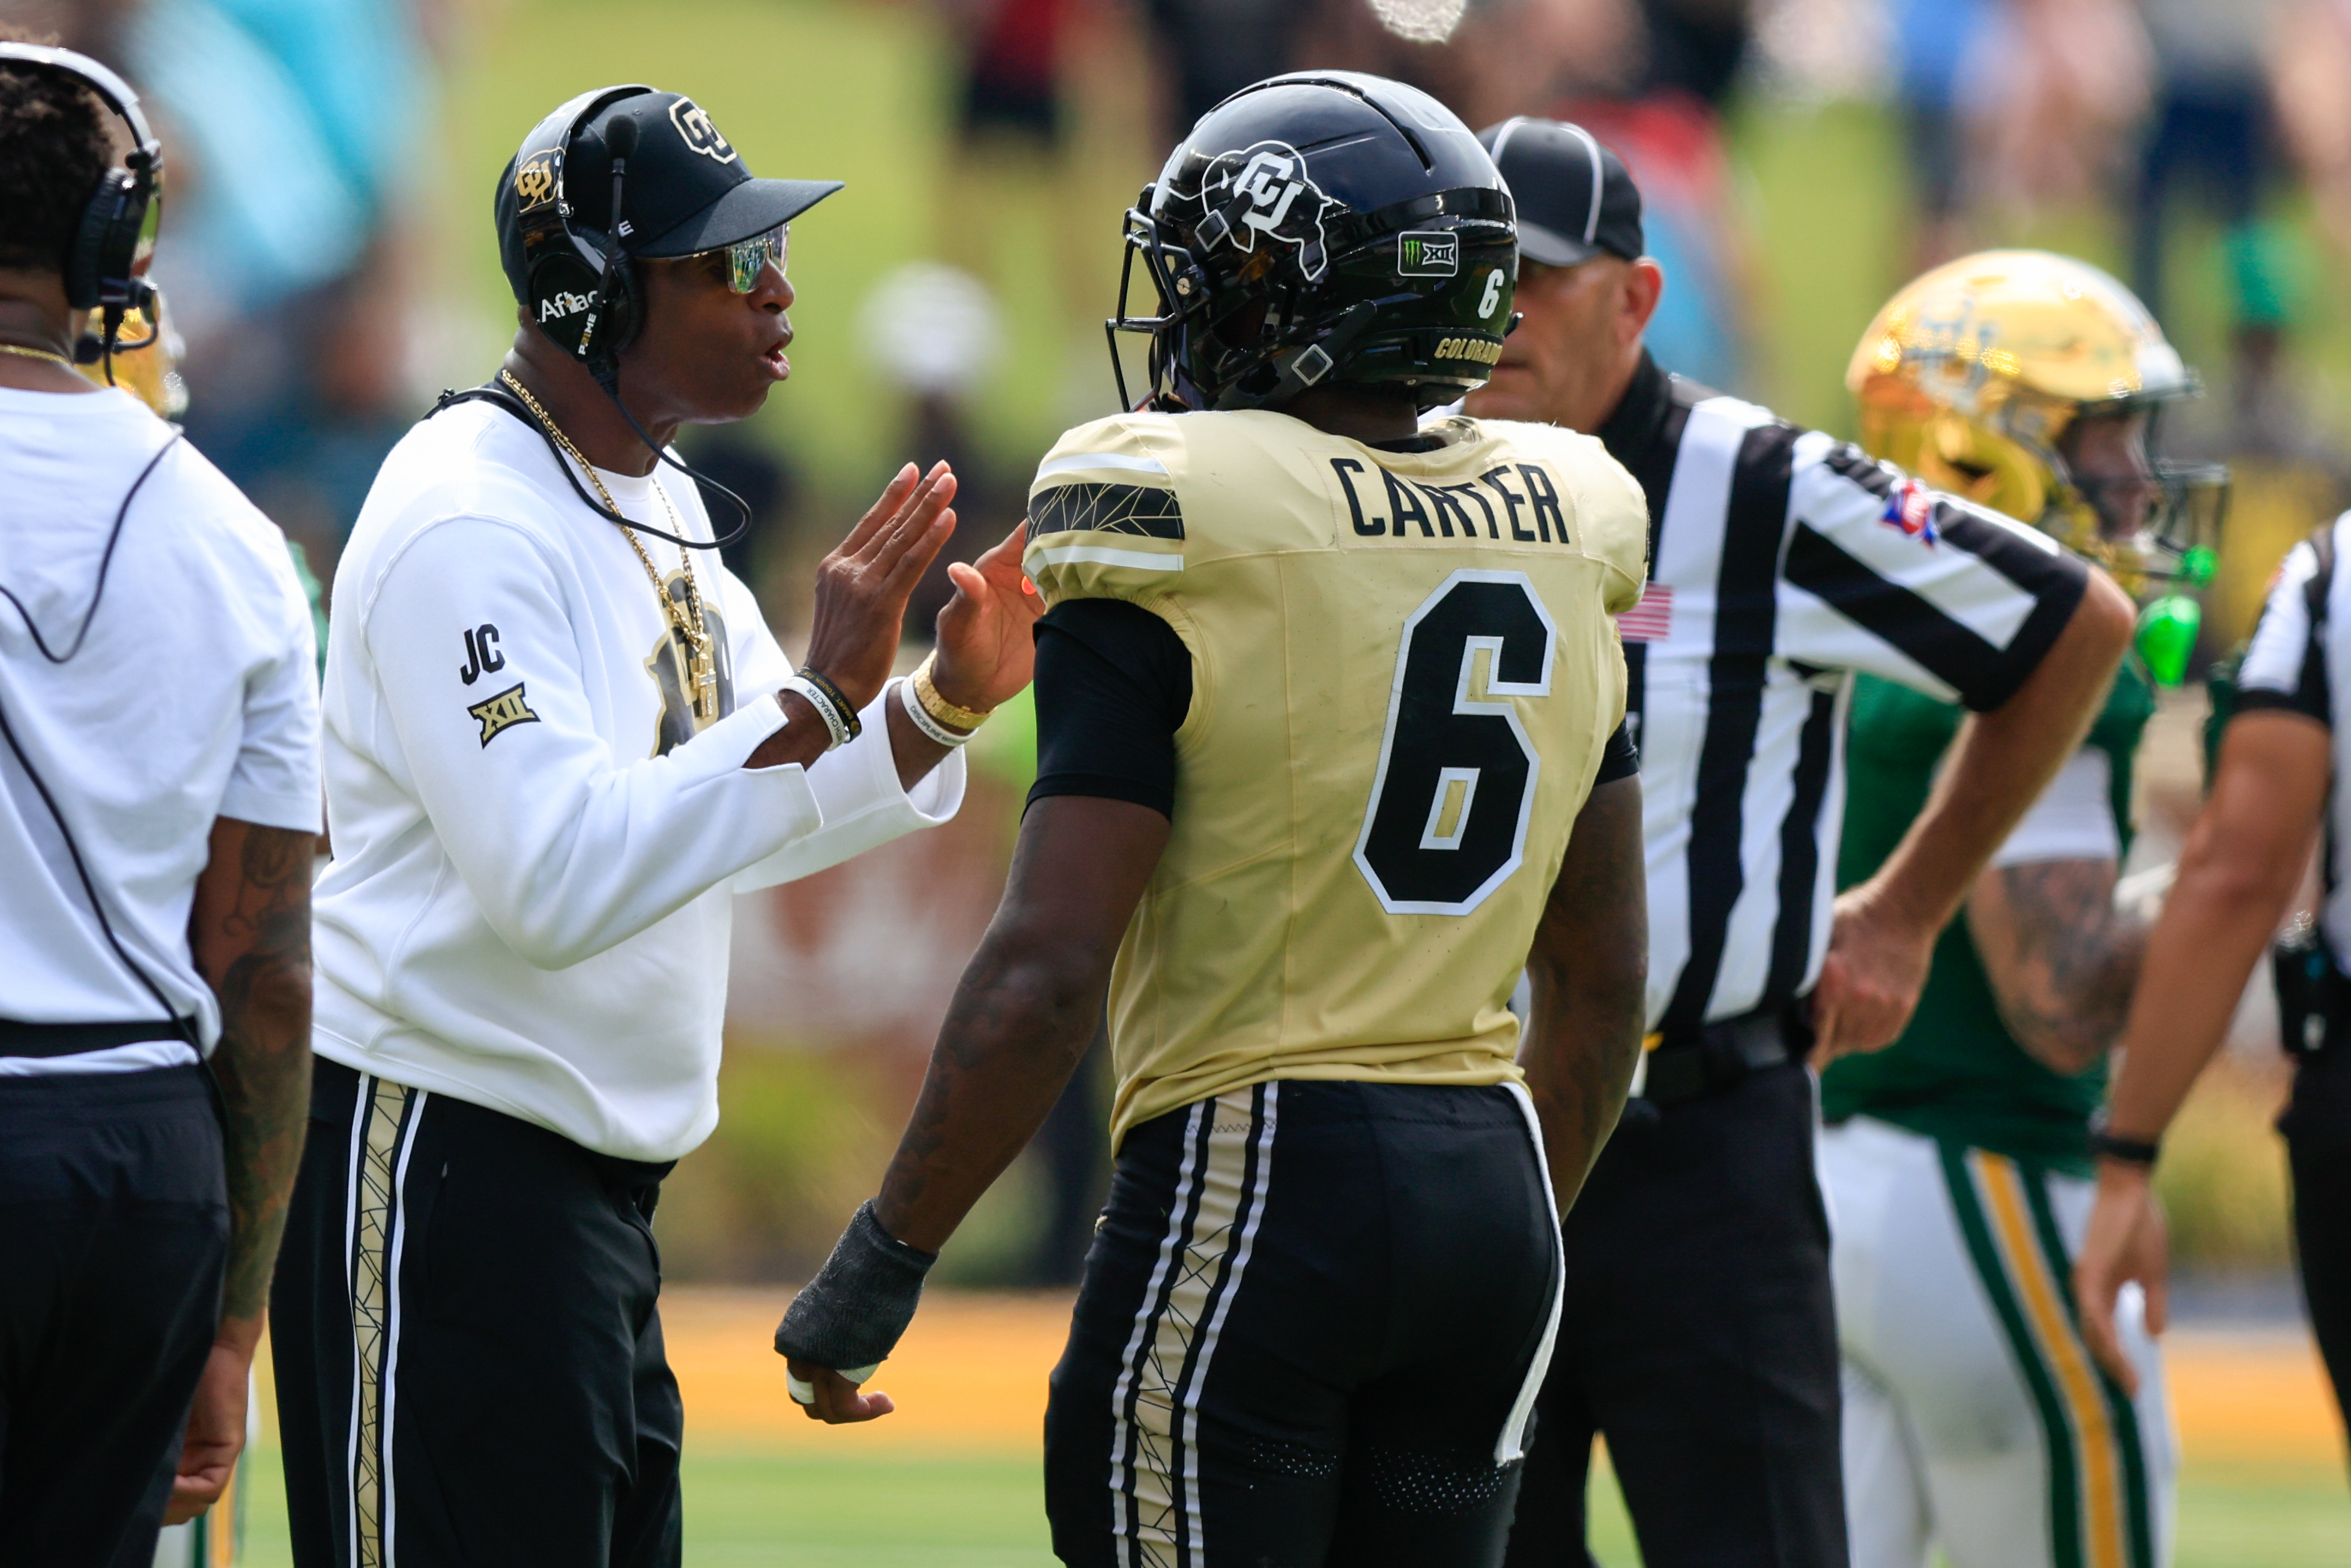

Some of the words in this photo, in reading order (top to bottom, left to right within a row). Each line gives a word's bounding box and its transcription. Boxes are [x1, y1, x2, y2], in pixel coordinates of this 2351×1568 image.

[1477, 268, 1505, 319] 6
[1330, 457, 1570, 544] CARTER
[460, 623, 506, 686] JC
[806, 687, 839, 727] CHARACTER
[1352, 568, 1557, 916] 6
